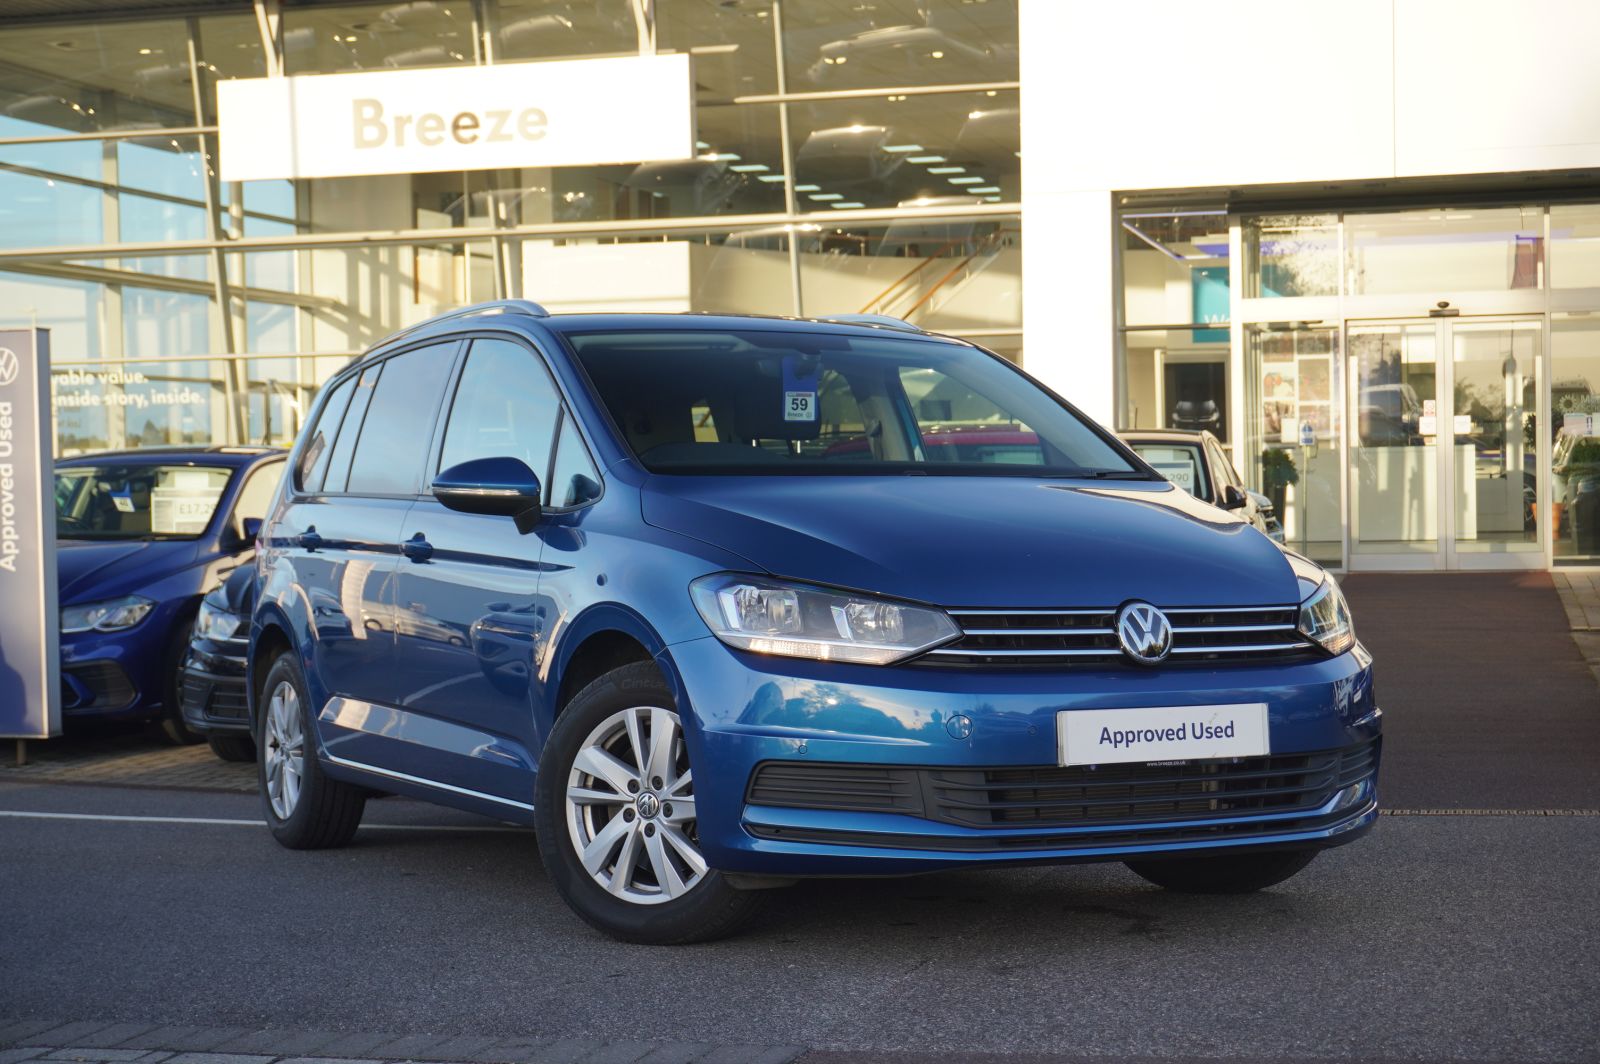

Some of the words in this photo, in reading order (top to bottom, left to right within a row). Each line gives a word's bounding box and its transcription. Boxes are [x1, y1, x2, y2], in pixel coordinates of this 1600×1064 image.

[352, 98, 548, 149] Breeze
[98, 369, 149, 384] value.
[103, 391, 148, 409] story,
[151, 387, 205, 404] inside.
[791, 397, 808, 411] 59
[0, 401, 14, 457] Used
[0, 463, 19, 572] Approved
[1099, 722, 1187, 749] Approved
[1191, 720, 1235, 740] Used
